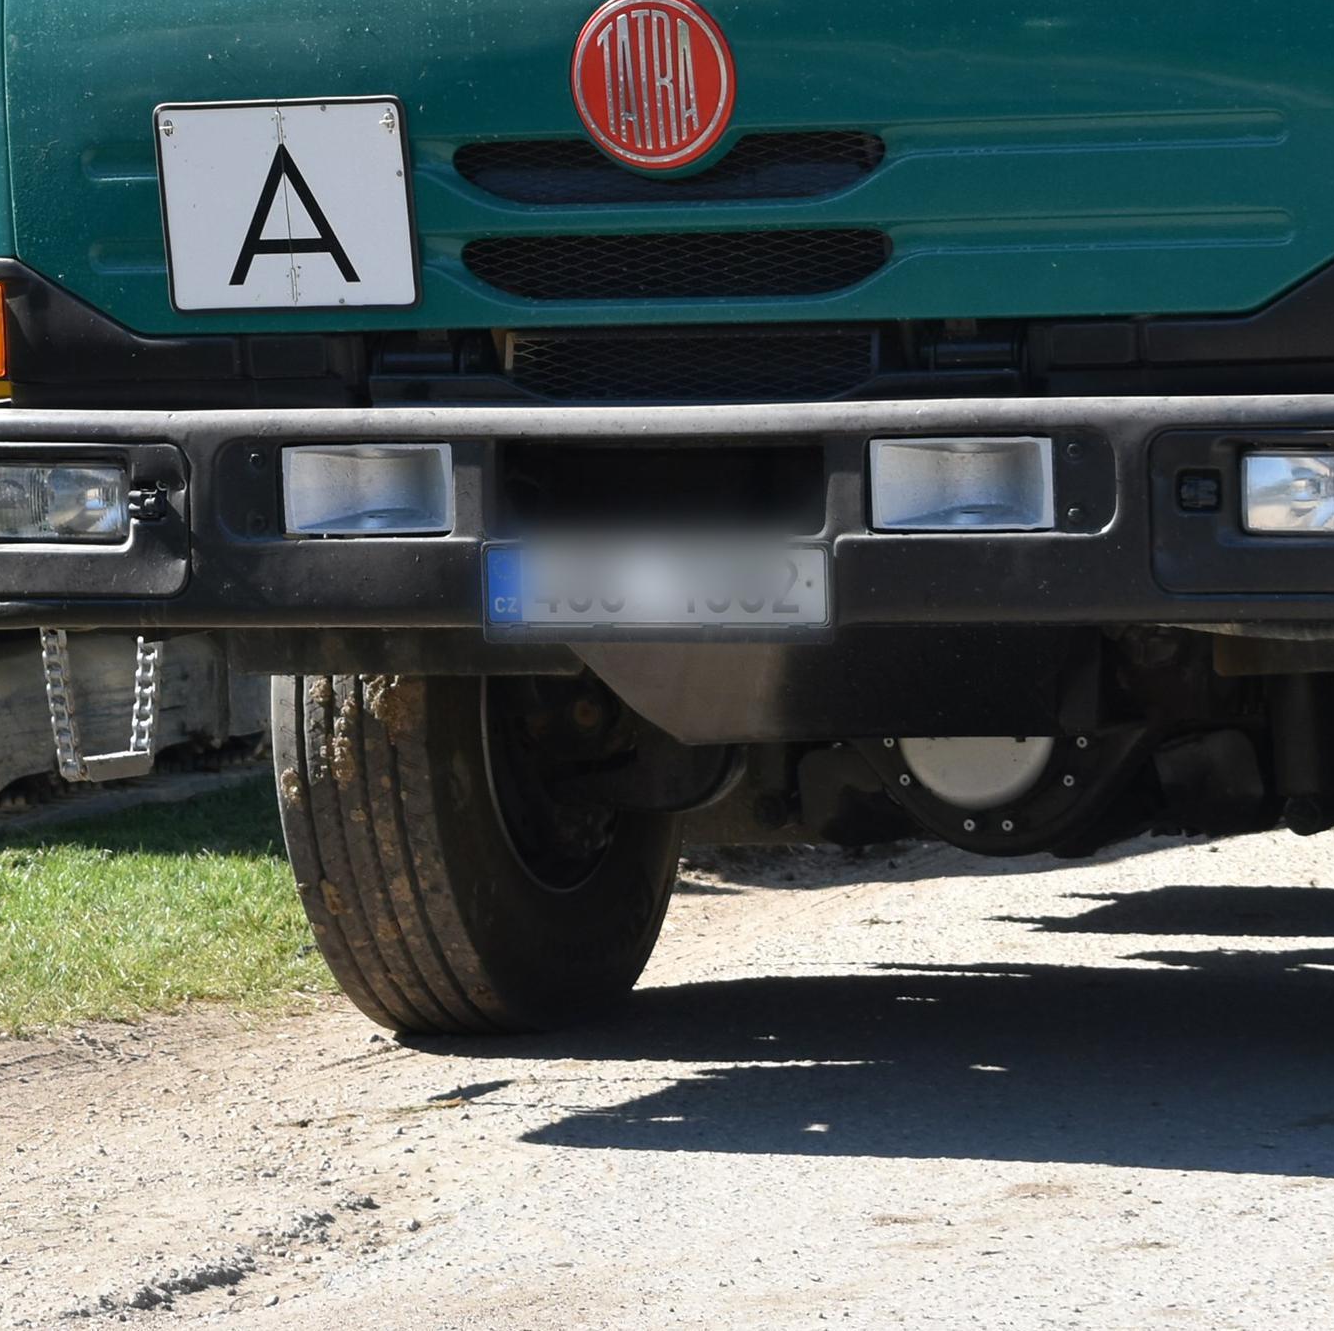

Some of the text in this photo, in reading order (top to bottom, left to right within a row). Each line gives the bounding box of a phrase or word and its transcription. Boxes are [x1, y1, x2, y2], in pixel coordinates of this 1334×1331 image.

[597, 9, 700, 150] TATRA
[229, 143, 361, 286] A
[494, 596, 518, 613] CZ
